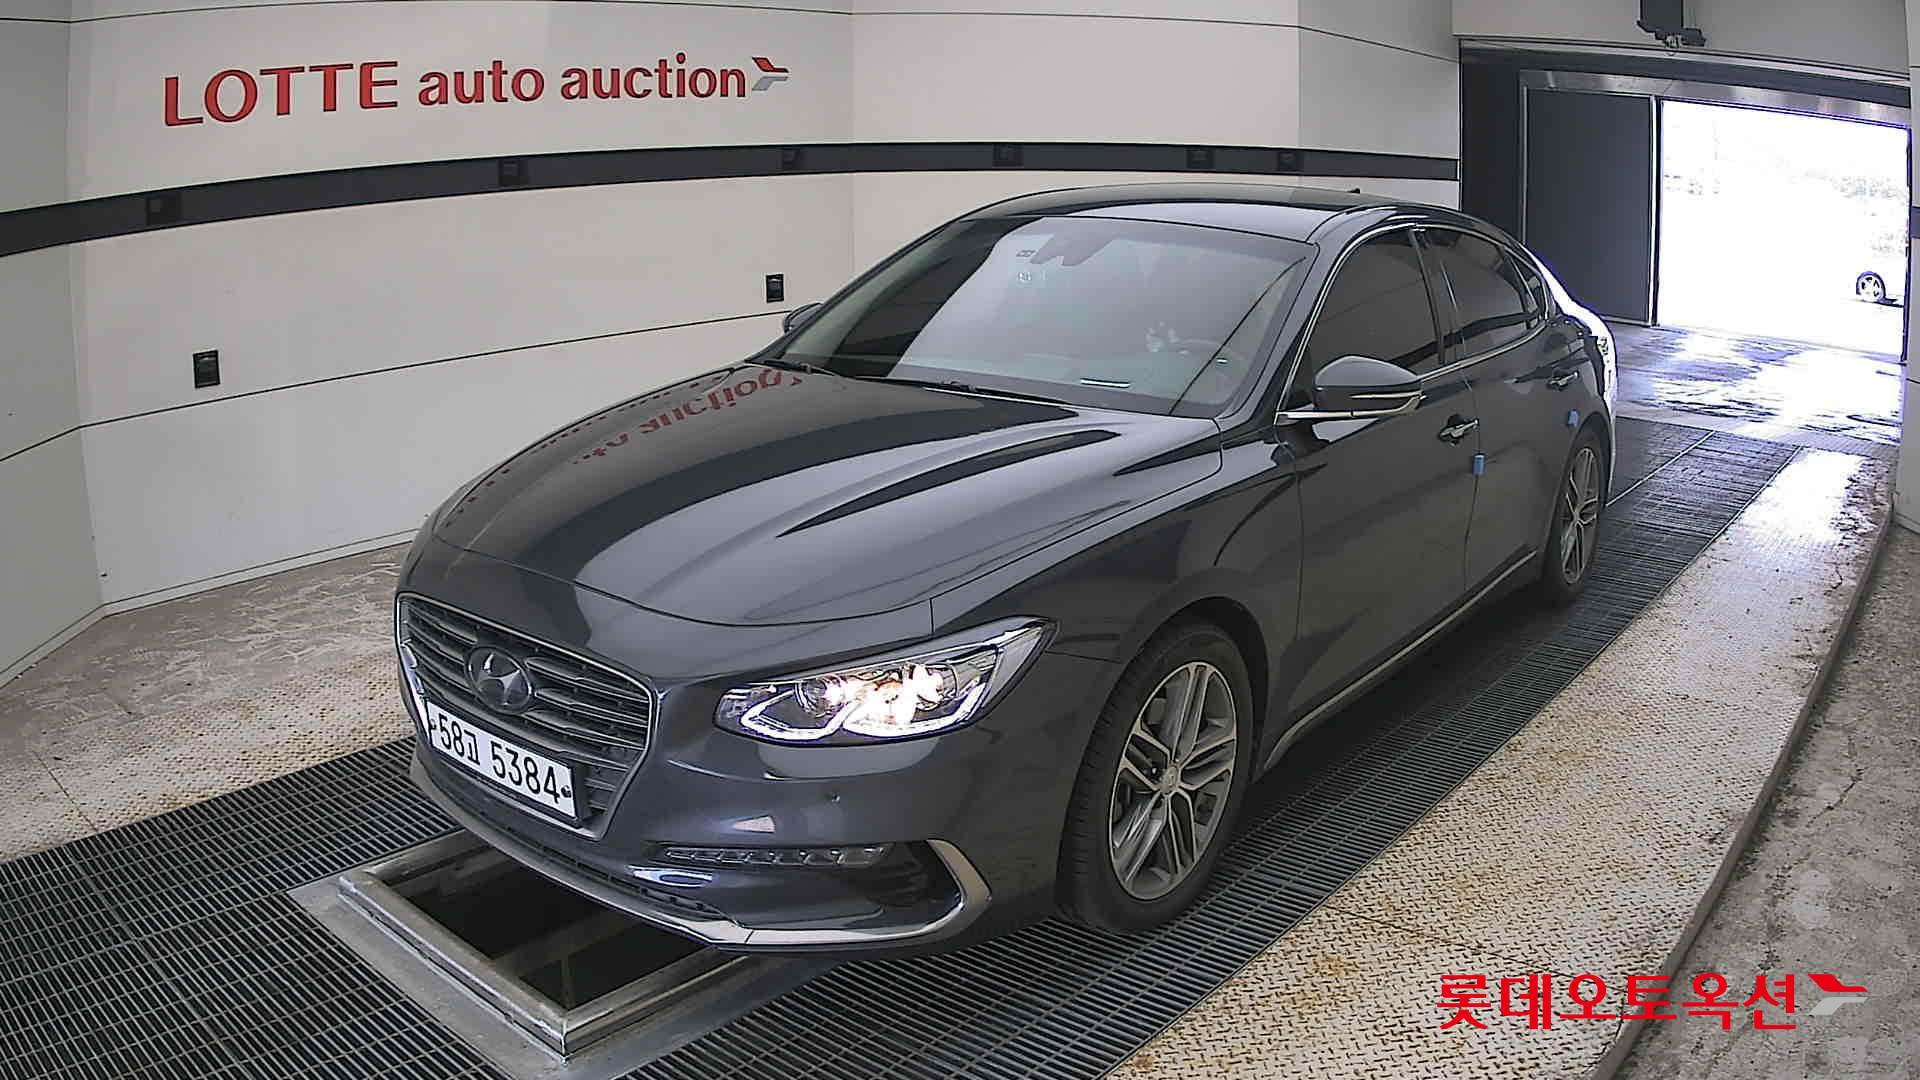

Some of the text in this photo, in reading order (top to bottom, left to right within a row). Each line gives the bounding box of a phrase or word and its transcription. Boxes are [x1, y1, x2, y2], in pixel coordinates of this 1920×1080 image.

[164, 52, 746, 127] LOTTE auto auction
[491, 740, 560, 804] 5384
